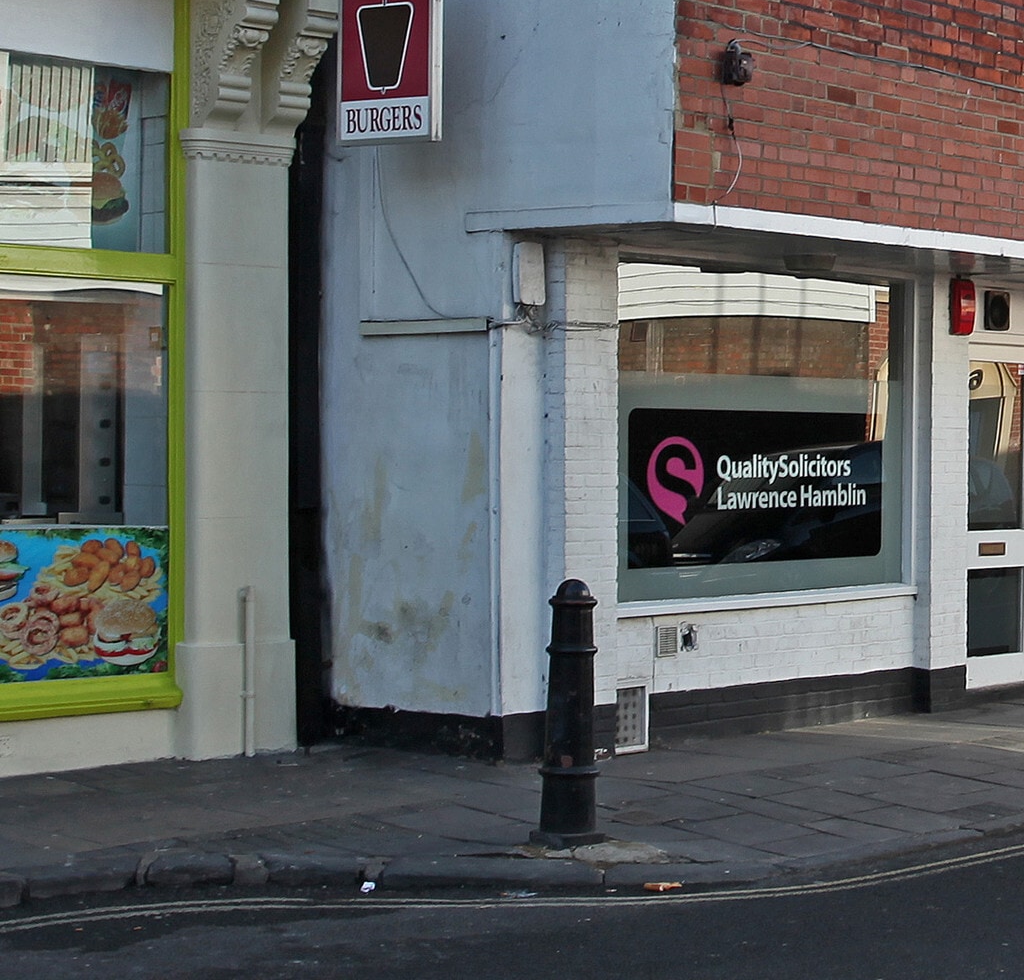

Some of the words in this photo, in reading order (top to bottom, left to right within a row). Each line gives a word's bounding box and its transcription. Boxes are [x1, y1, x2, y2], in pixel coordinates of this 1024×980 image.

[346, 104, 423, 135] BURGERS
[716, 454, 851, 484] QualitySolicitors
[717, 485, 797, 510] Lawrence
[800, 483, 866, 508] Hamblin
